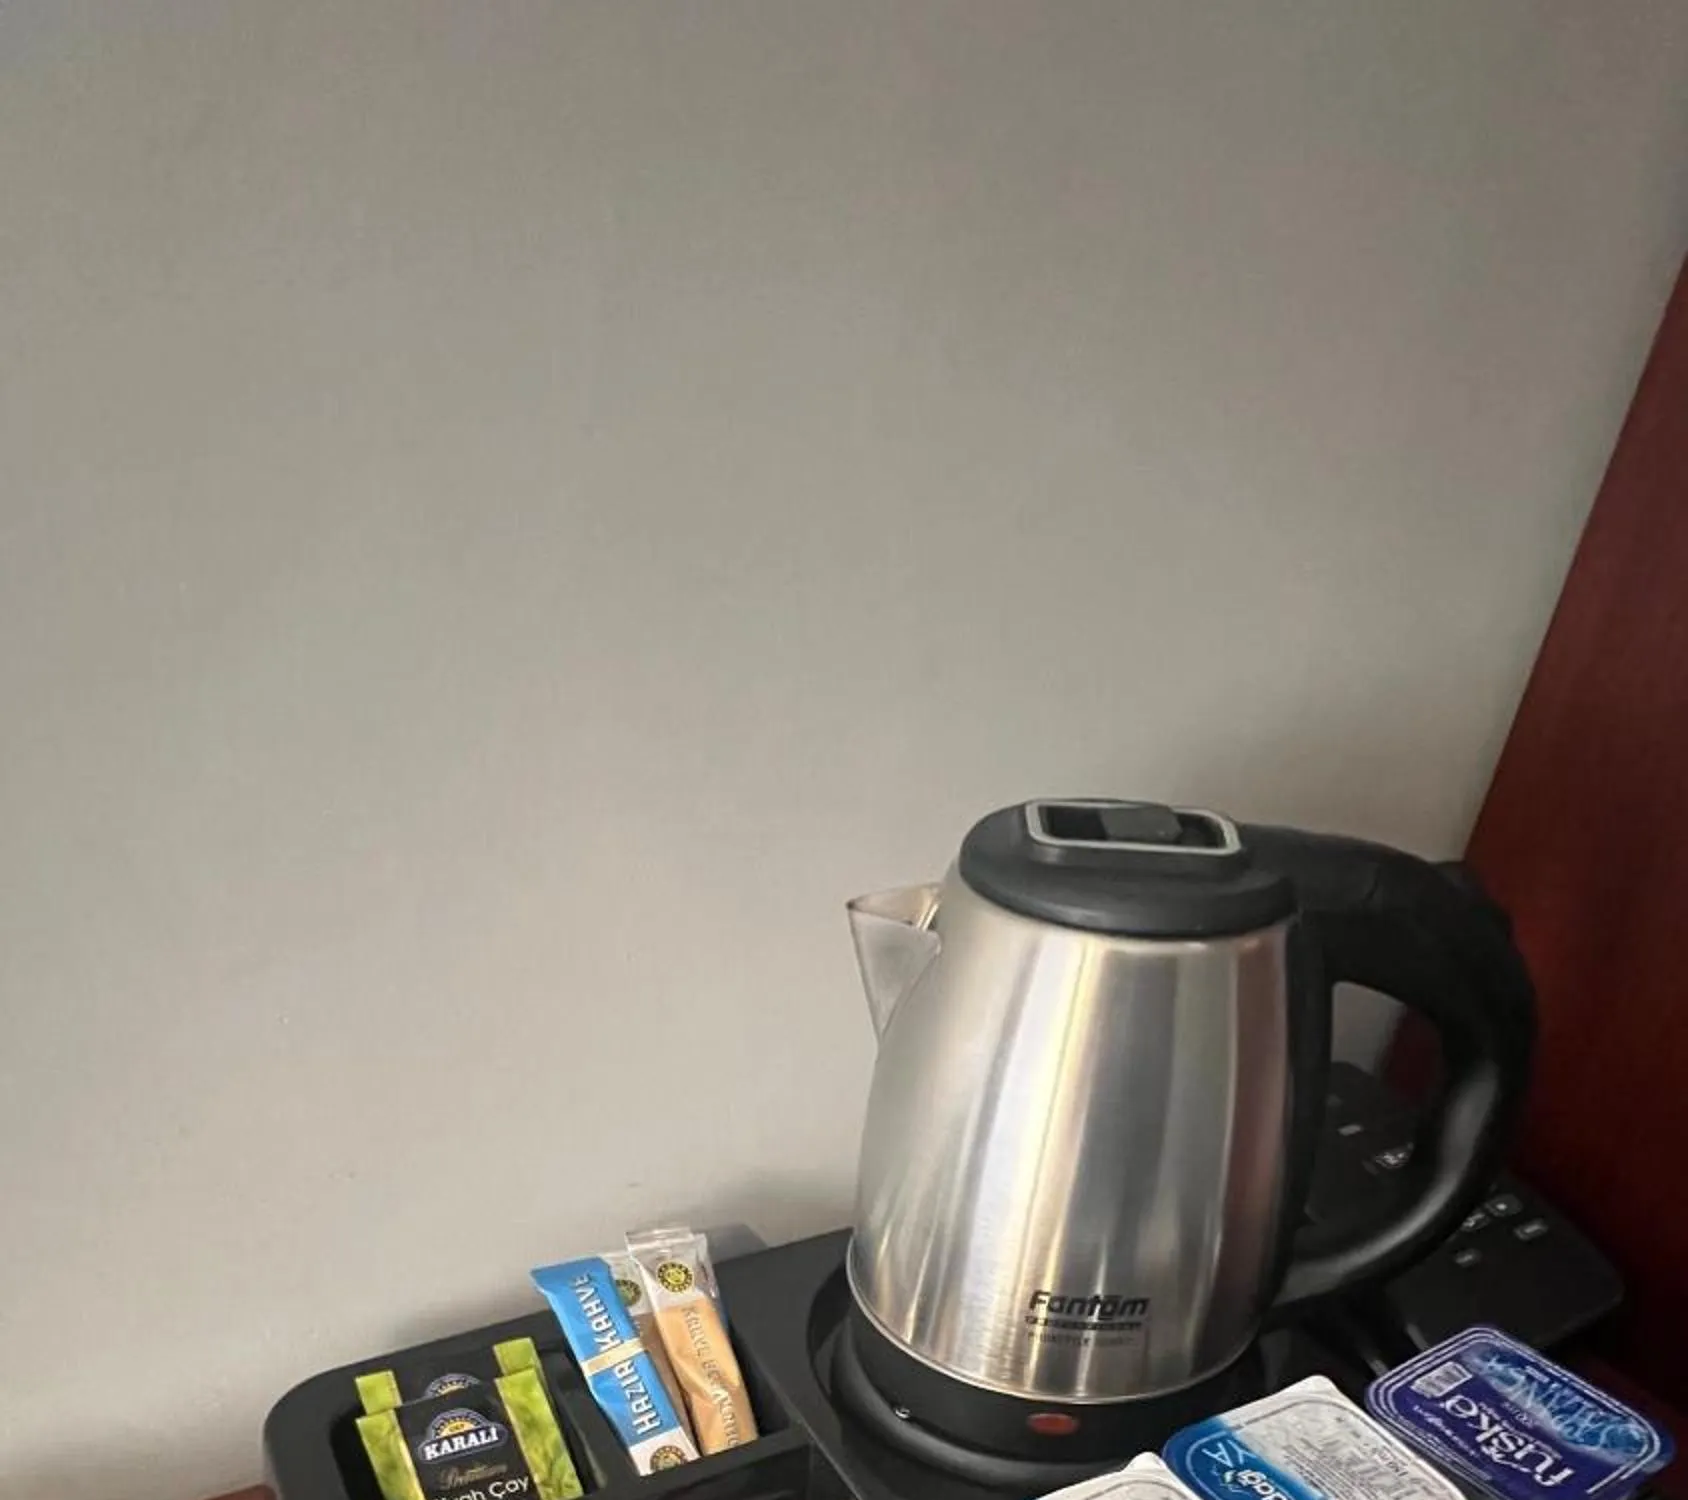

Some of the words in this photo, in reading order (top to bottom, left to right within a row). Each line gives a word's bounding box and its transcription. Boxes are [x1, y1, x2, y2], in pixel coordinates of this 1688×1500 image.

[575, 1272, 622, 1351] KAHVE
[614, 1359, 661, 1435] HAZIR
[488, 1476, 530, 1500] Çay
